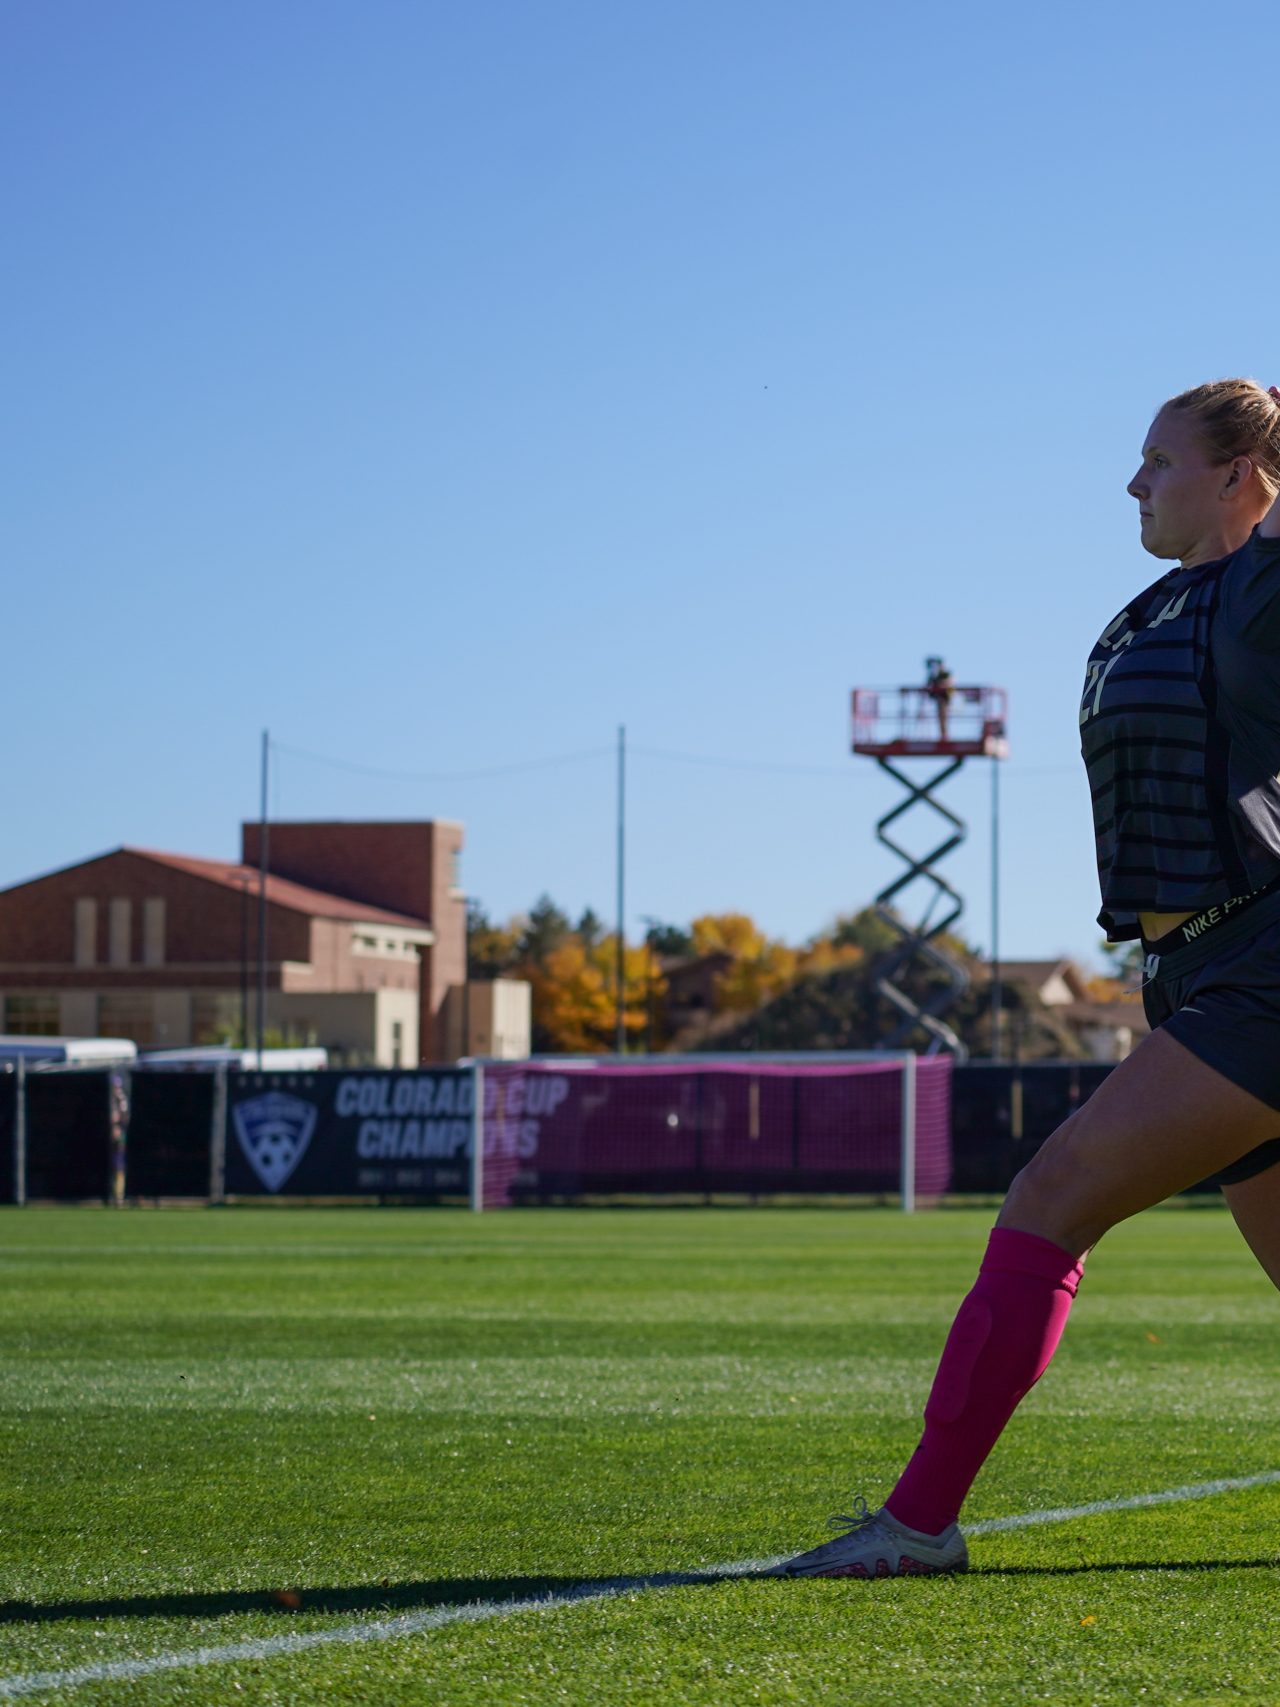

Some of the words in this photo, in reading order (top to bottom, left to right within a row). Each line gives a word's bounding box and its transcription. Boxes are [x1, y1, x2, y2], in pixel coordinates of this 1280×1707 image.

[1182, 905, 1222, 943] NIKE
[336, 1076, 498, 1117] COLORADO
[505, 1076, 570, 1118] CUP
